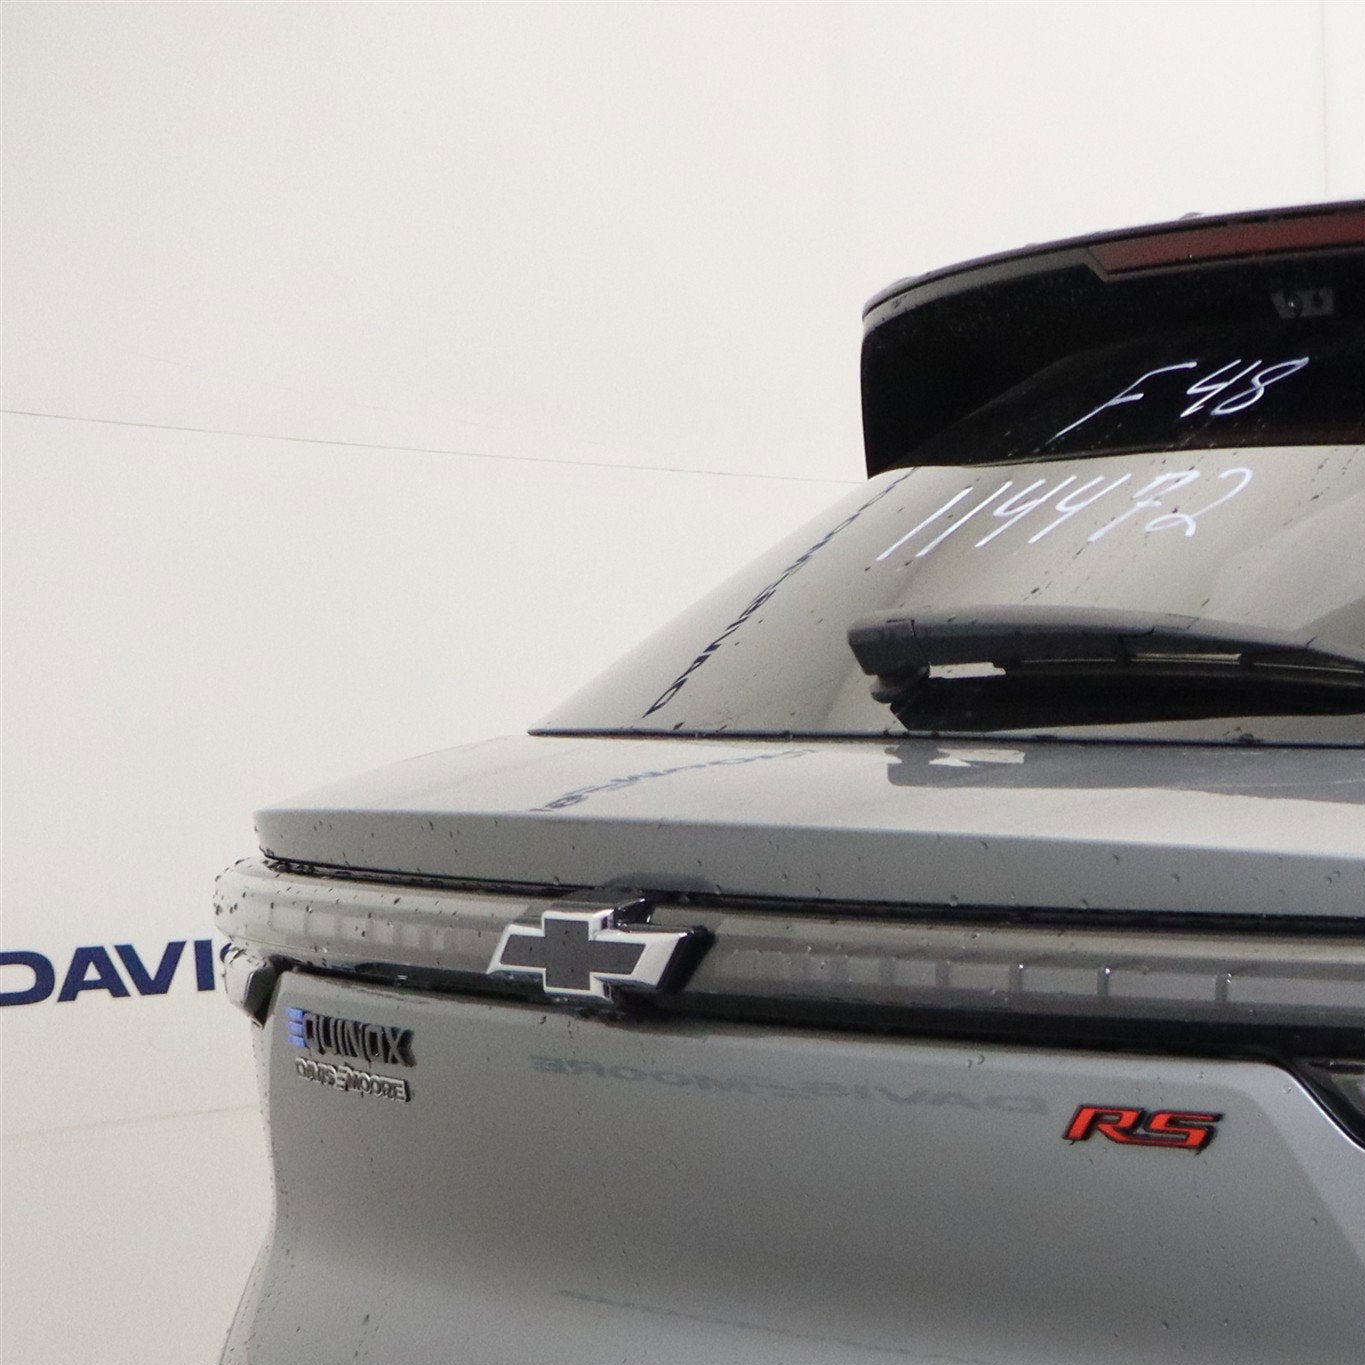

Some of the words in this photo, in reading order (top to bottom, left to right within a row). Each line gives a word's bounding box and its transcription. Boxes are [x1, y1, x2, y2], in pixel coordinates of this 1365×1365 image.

[1046, 361, 1197, 444] F
[1180, 357, 1309, 418] 48
[0, 939, 232, 1007] DAVI
[286, 1007, 417, 1068] EQUINOX
[1062, 1104, 1226, 1152] RS
